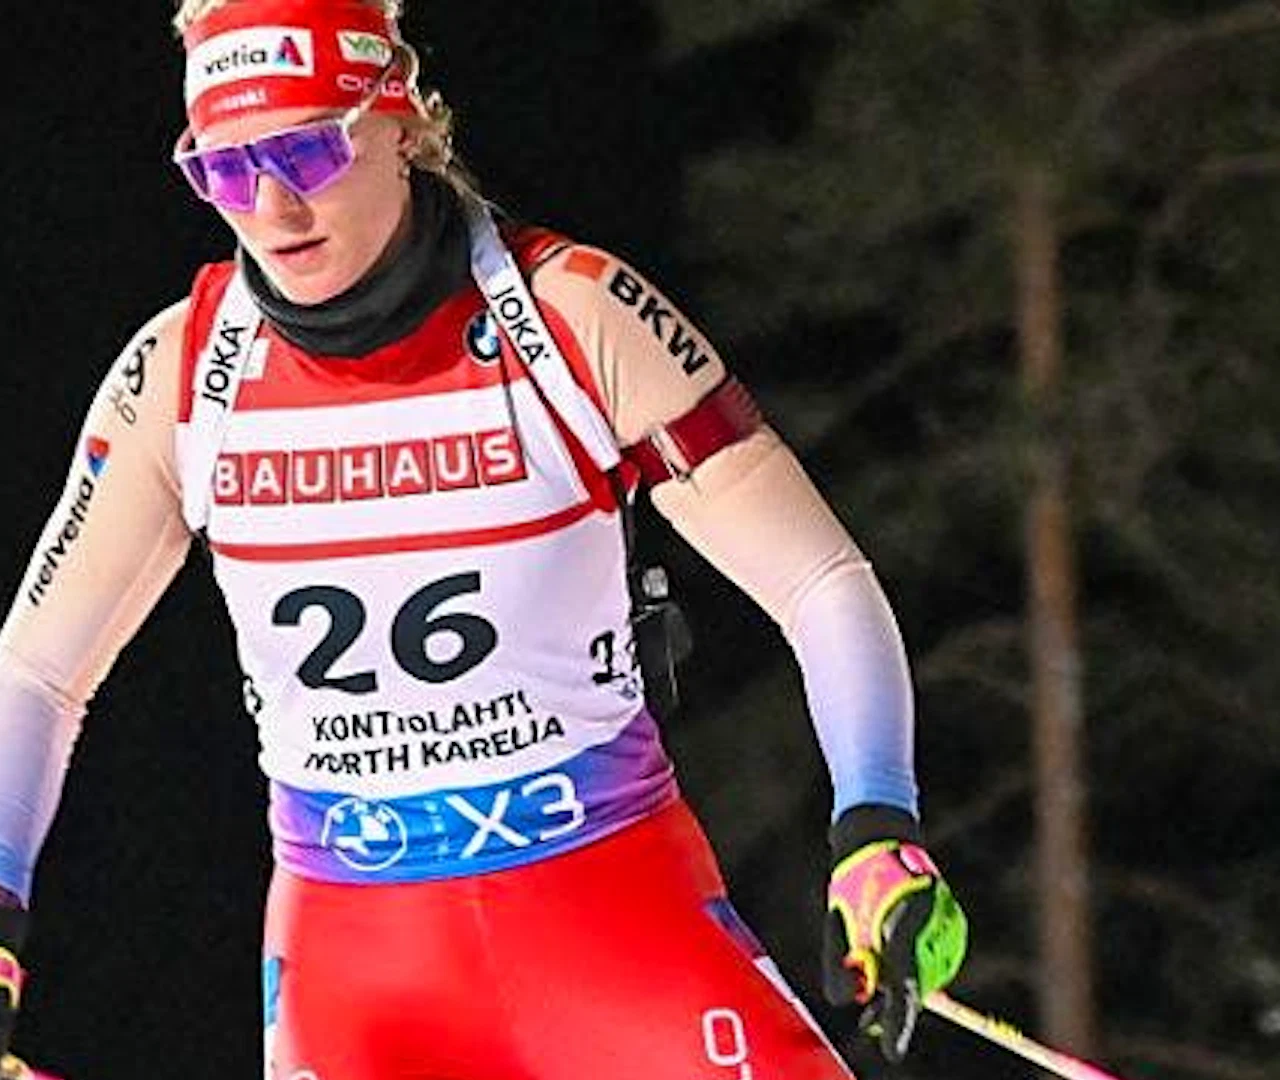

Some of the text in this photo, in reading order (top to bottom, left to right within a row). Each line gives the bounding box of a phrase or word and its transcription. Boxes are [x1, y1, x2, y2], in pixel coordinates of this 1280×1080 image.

[202, 322, 246, 408] JOKA
[491, 284, 547, 364] JOKA
[609, 269, 709, 377] BKW
[214, 433, 520, 498] BAUHAUS
[27, 475, 95, 607] helvetia
[271, 570, 498, 695] 26
[421, 716, 566, 768] KARELIA
[444, 772, 586, 859] X3
